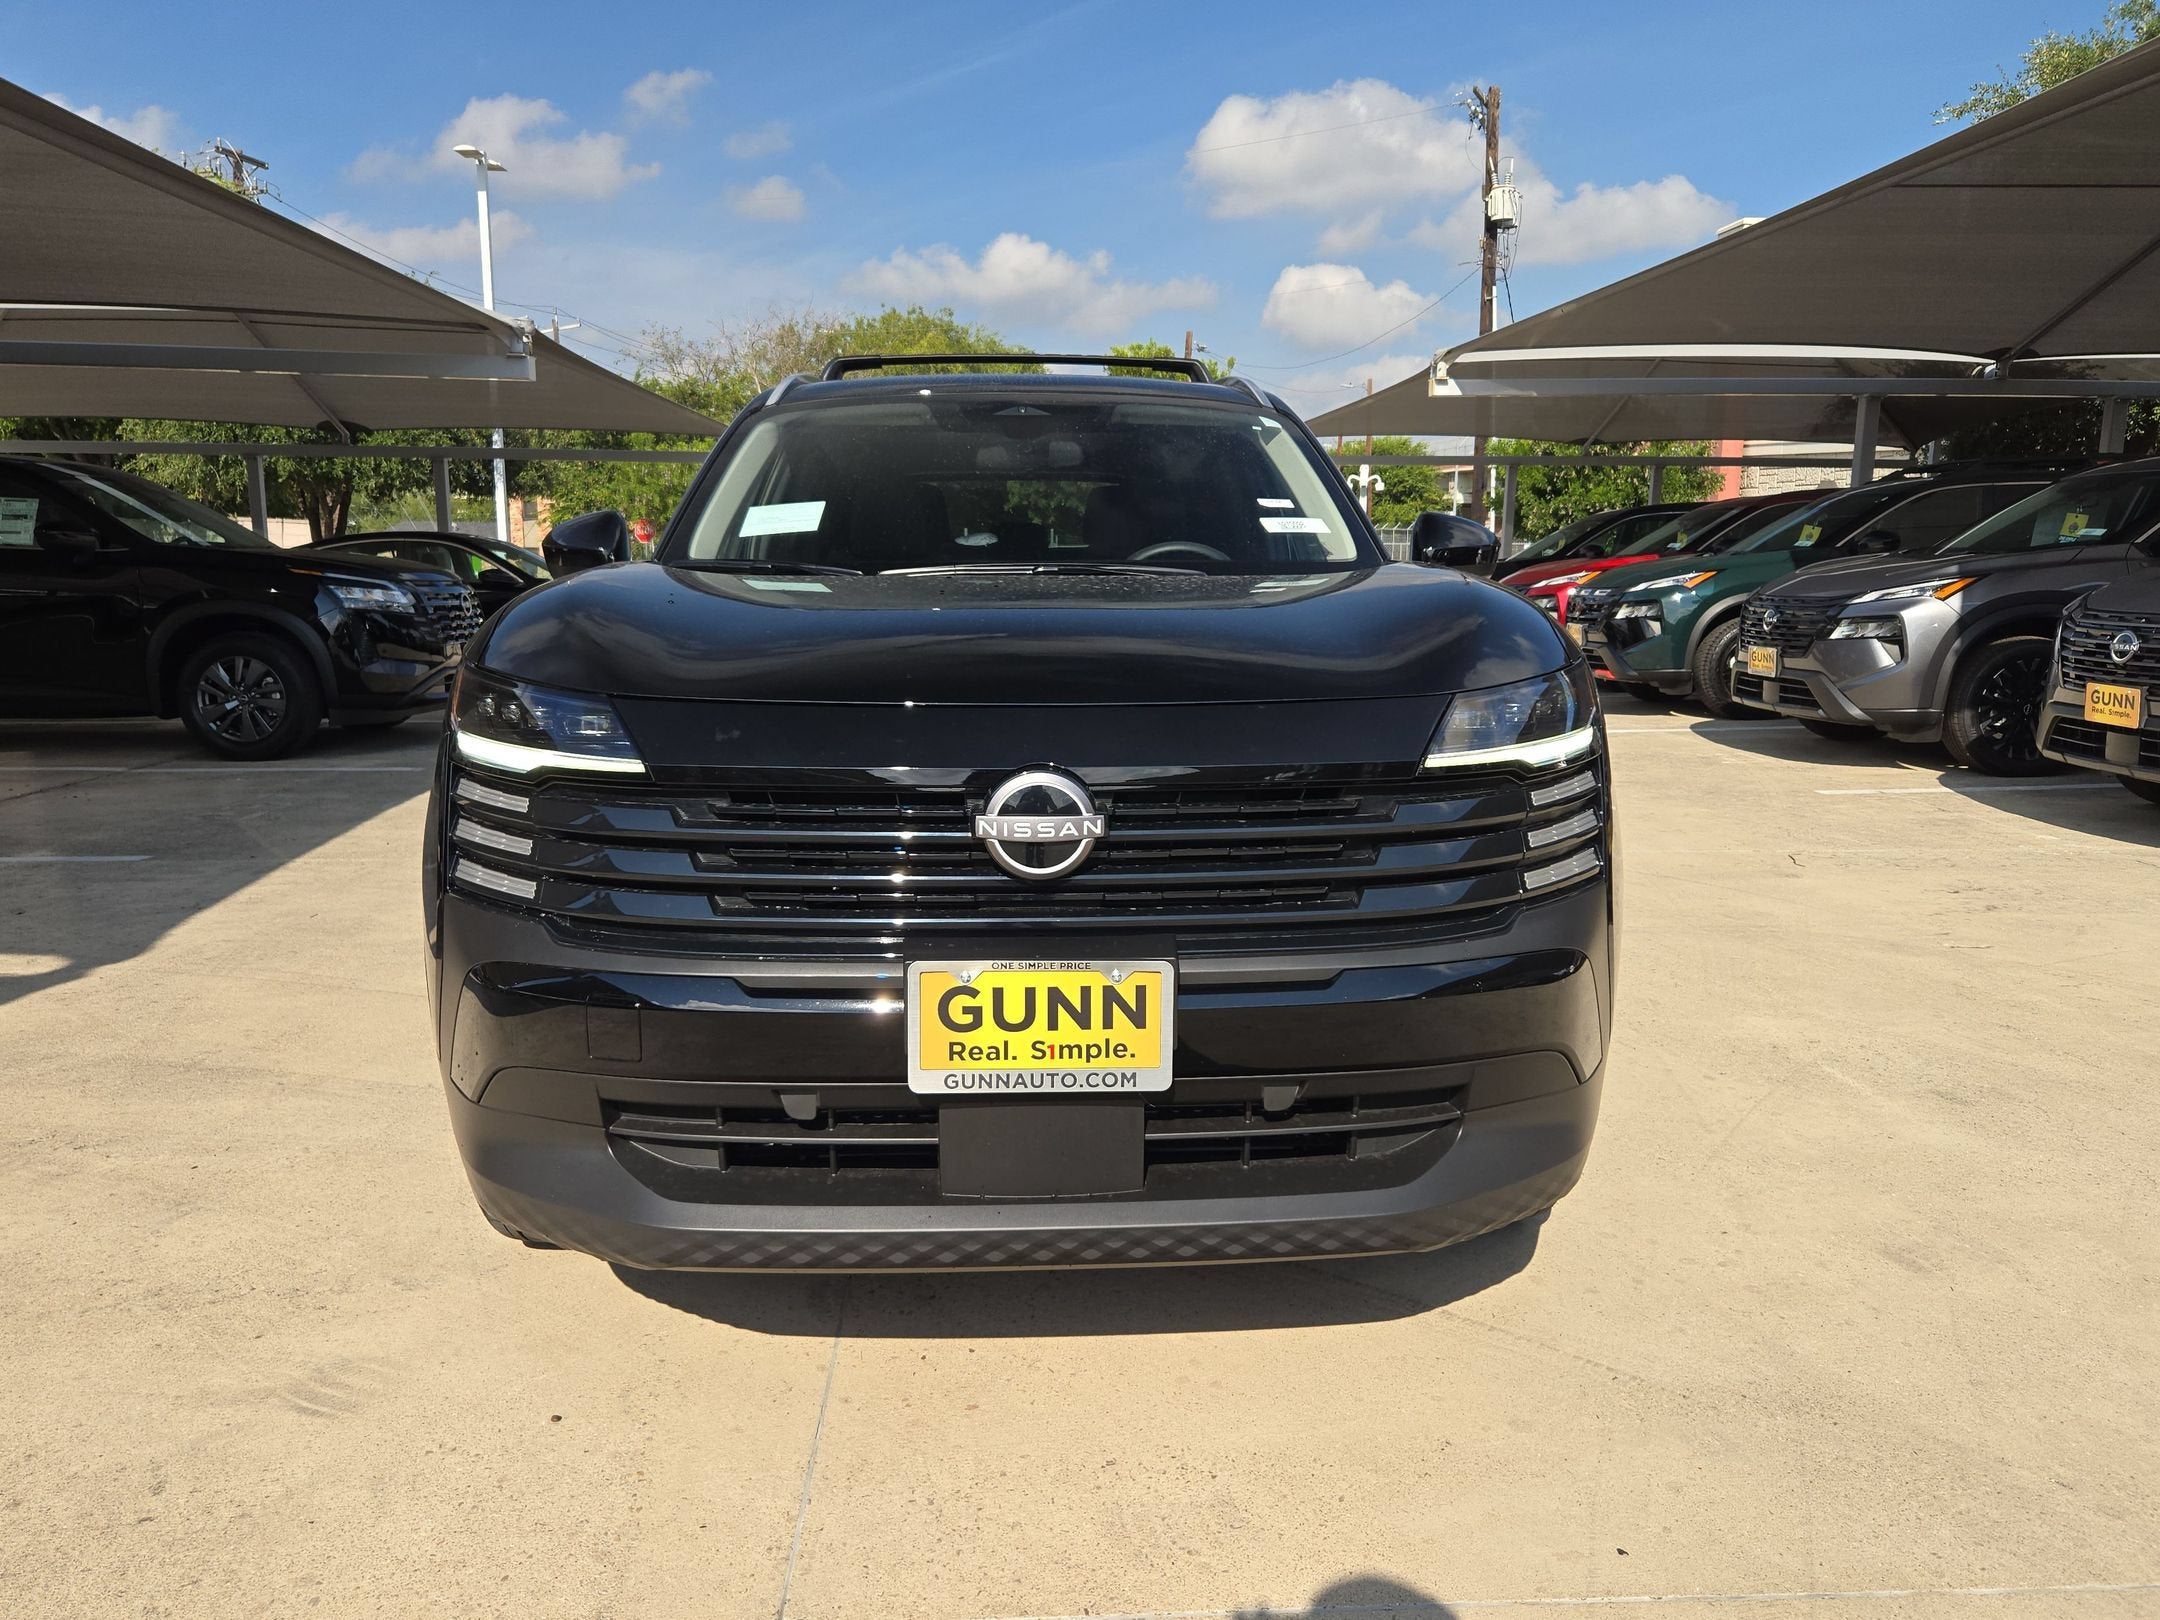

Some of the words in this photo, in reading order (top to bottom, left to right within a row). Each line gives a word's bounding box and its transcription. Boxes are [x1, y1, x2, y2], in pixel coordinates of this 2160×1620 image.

[1751, 651, 1774, 664] GUNN
[2091, 689, 2135, 710] GUNN
[978, 819, 1101, 838] NISSAN
[991, 961, 1017, 970] ONE
[1018, 961, 1057, 970] SIMPLE
[1059, 961, 1092, 970] PRICE
[937, 985, 1147, 1033] GUNN
[948, 1040, 1018, 1061] Real.
[943, 1071, 1137, 1090] GUNNAUTO.COM
